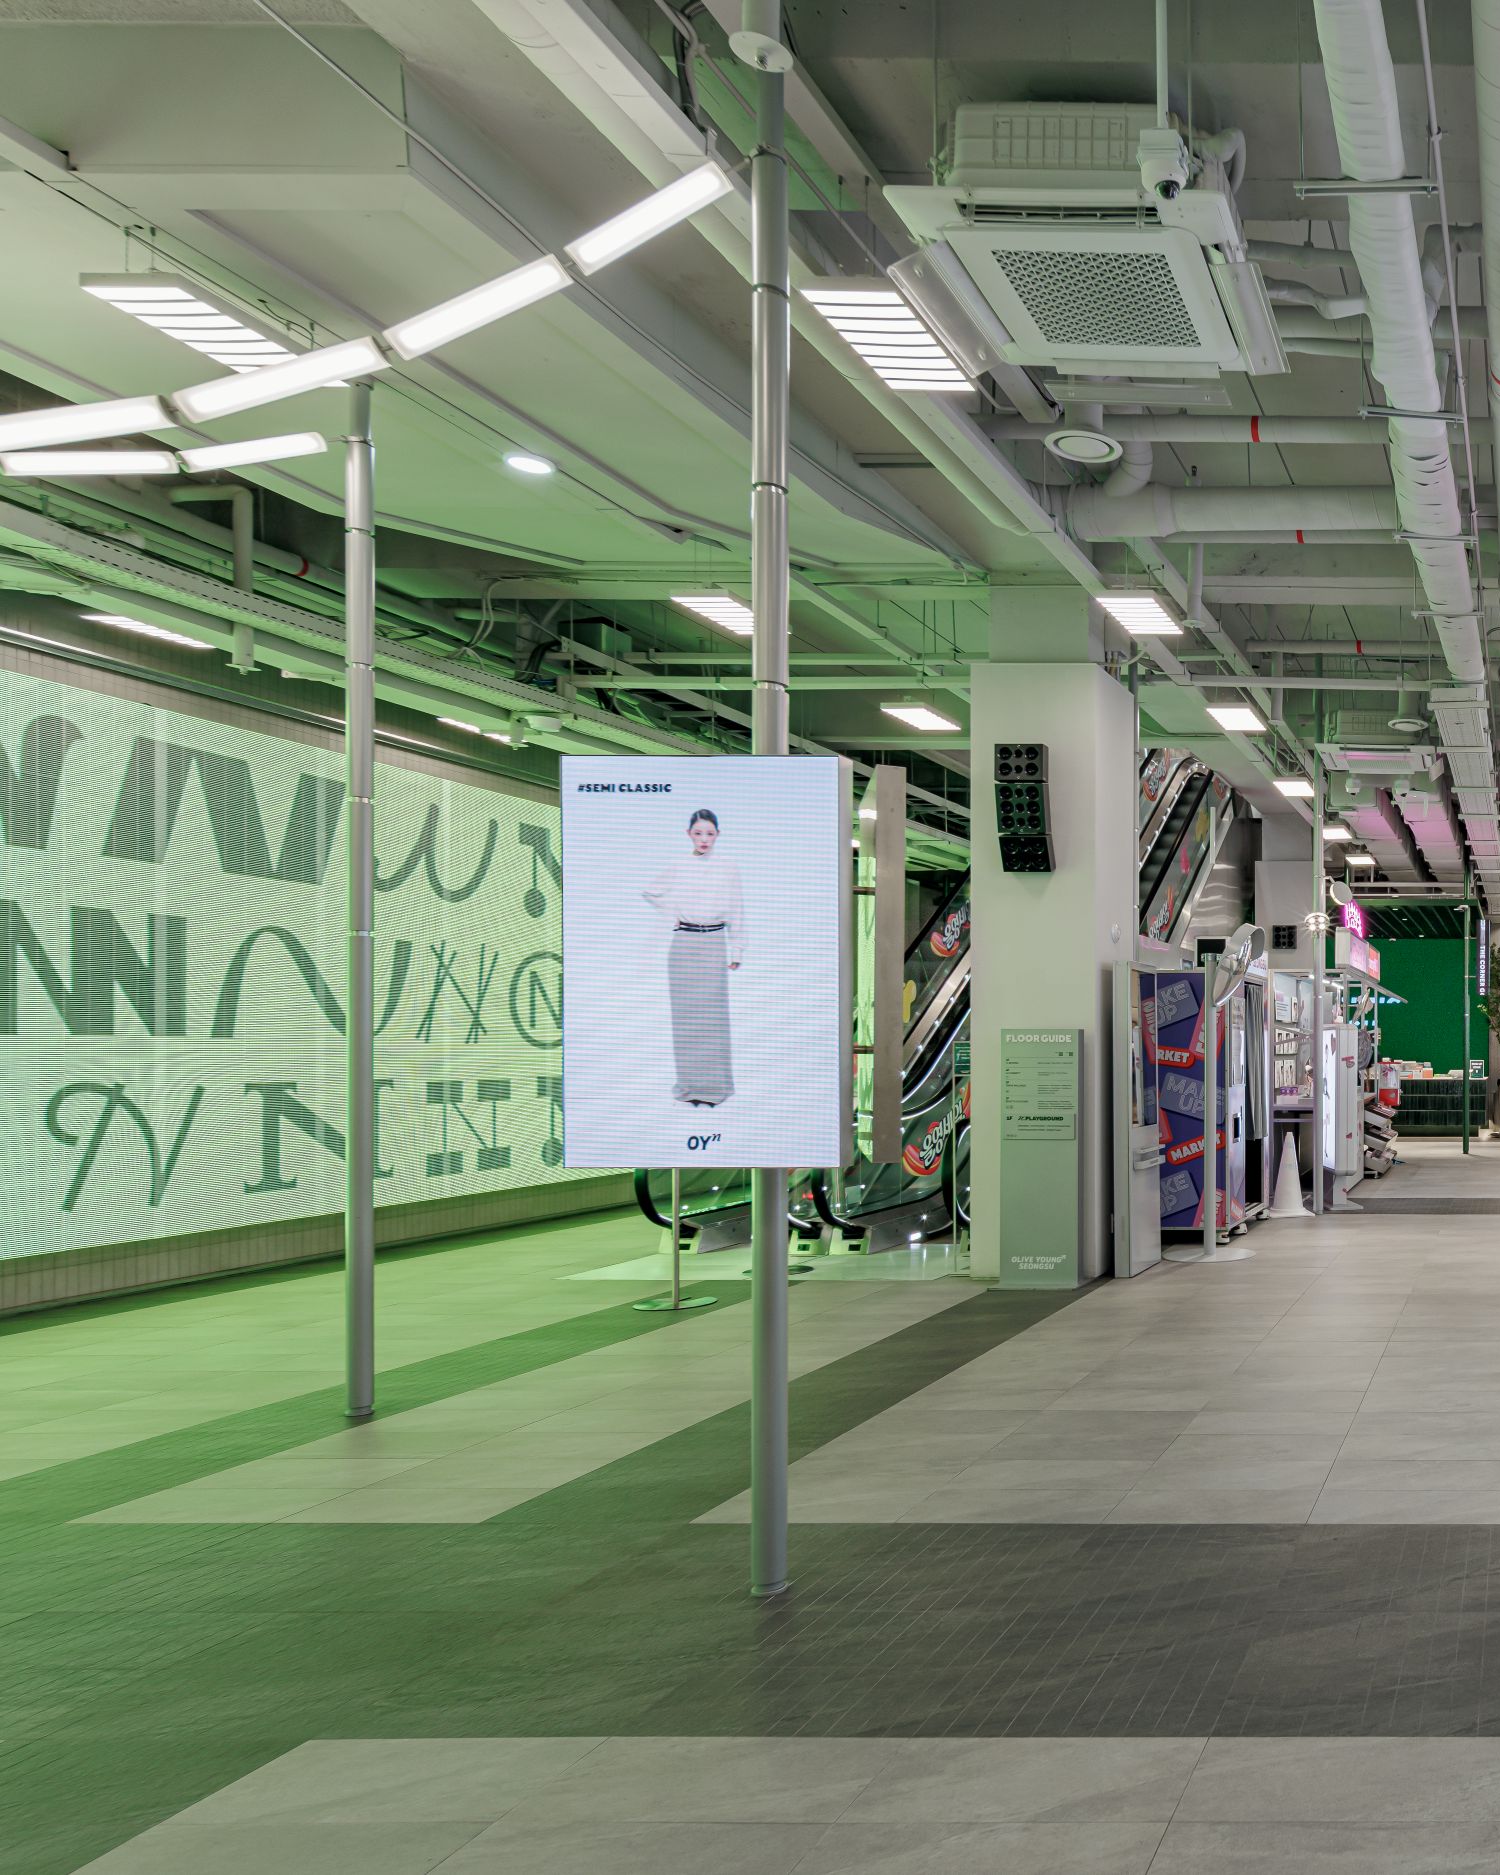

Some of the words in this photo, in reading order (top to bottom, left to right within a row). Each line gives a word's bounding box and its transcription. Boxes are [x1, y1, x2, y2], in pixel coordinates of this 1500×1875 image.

[578, 783, 616, 793] #SEMI
[618, 783, 672, 793] CLASSIC
[1006, 1034, 1040, 1043] FLOOR
[1040, 1034, 1072, 1043] GUIDE
[1018, 1262, 1055, 1270] SEONGSU
